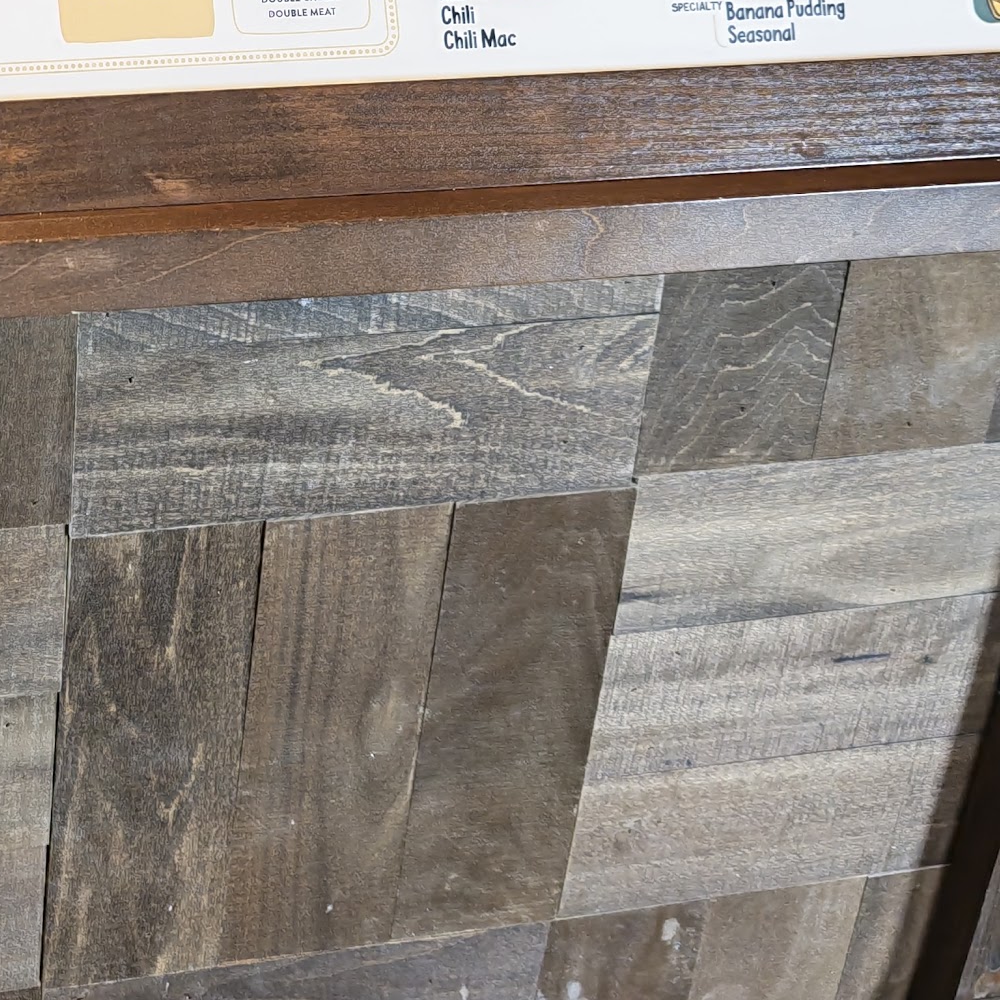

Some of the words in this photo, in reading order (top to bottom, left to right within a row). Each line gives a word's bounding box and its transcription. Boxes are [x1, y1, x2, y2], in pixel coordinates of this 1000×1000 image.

[442, 5, 474, 24] Chili
[672, 1, 722, 12] SPECIALTY
[726, 2, 783, 20] Banana
[444, 30, 477, 49] Chili
[481, 29, 516, 48] Mac
[728, 22, 795, 43] Seasonal
